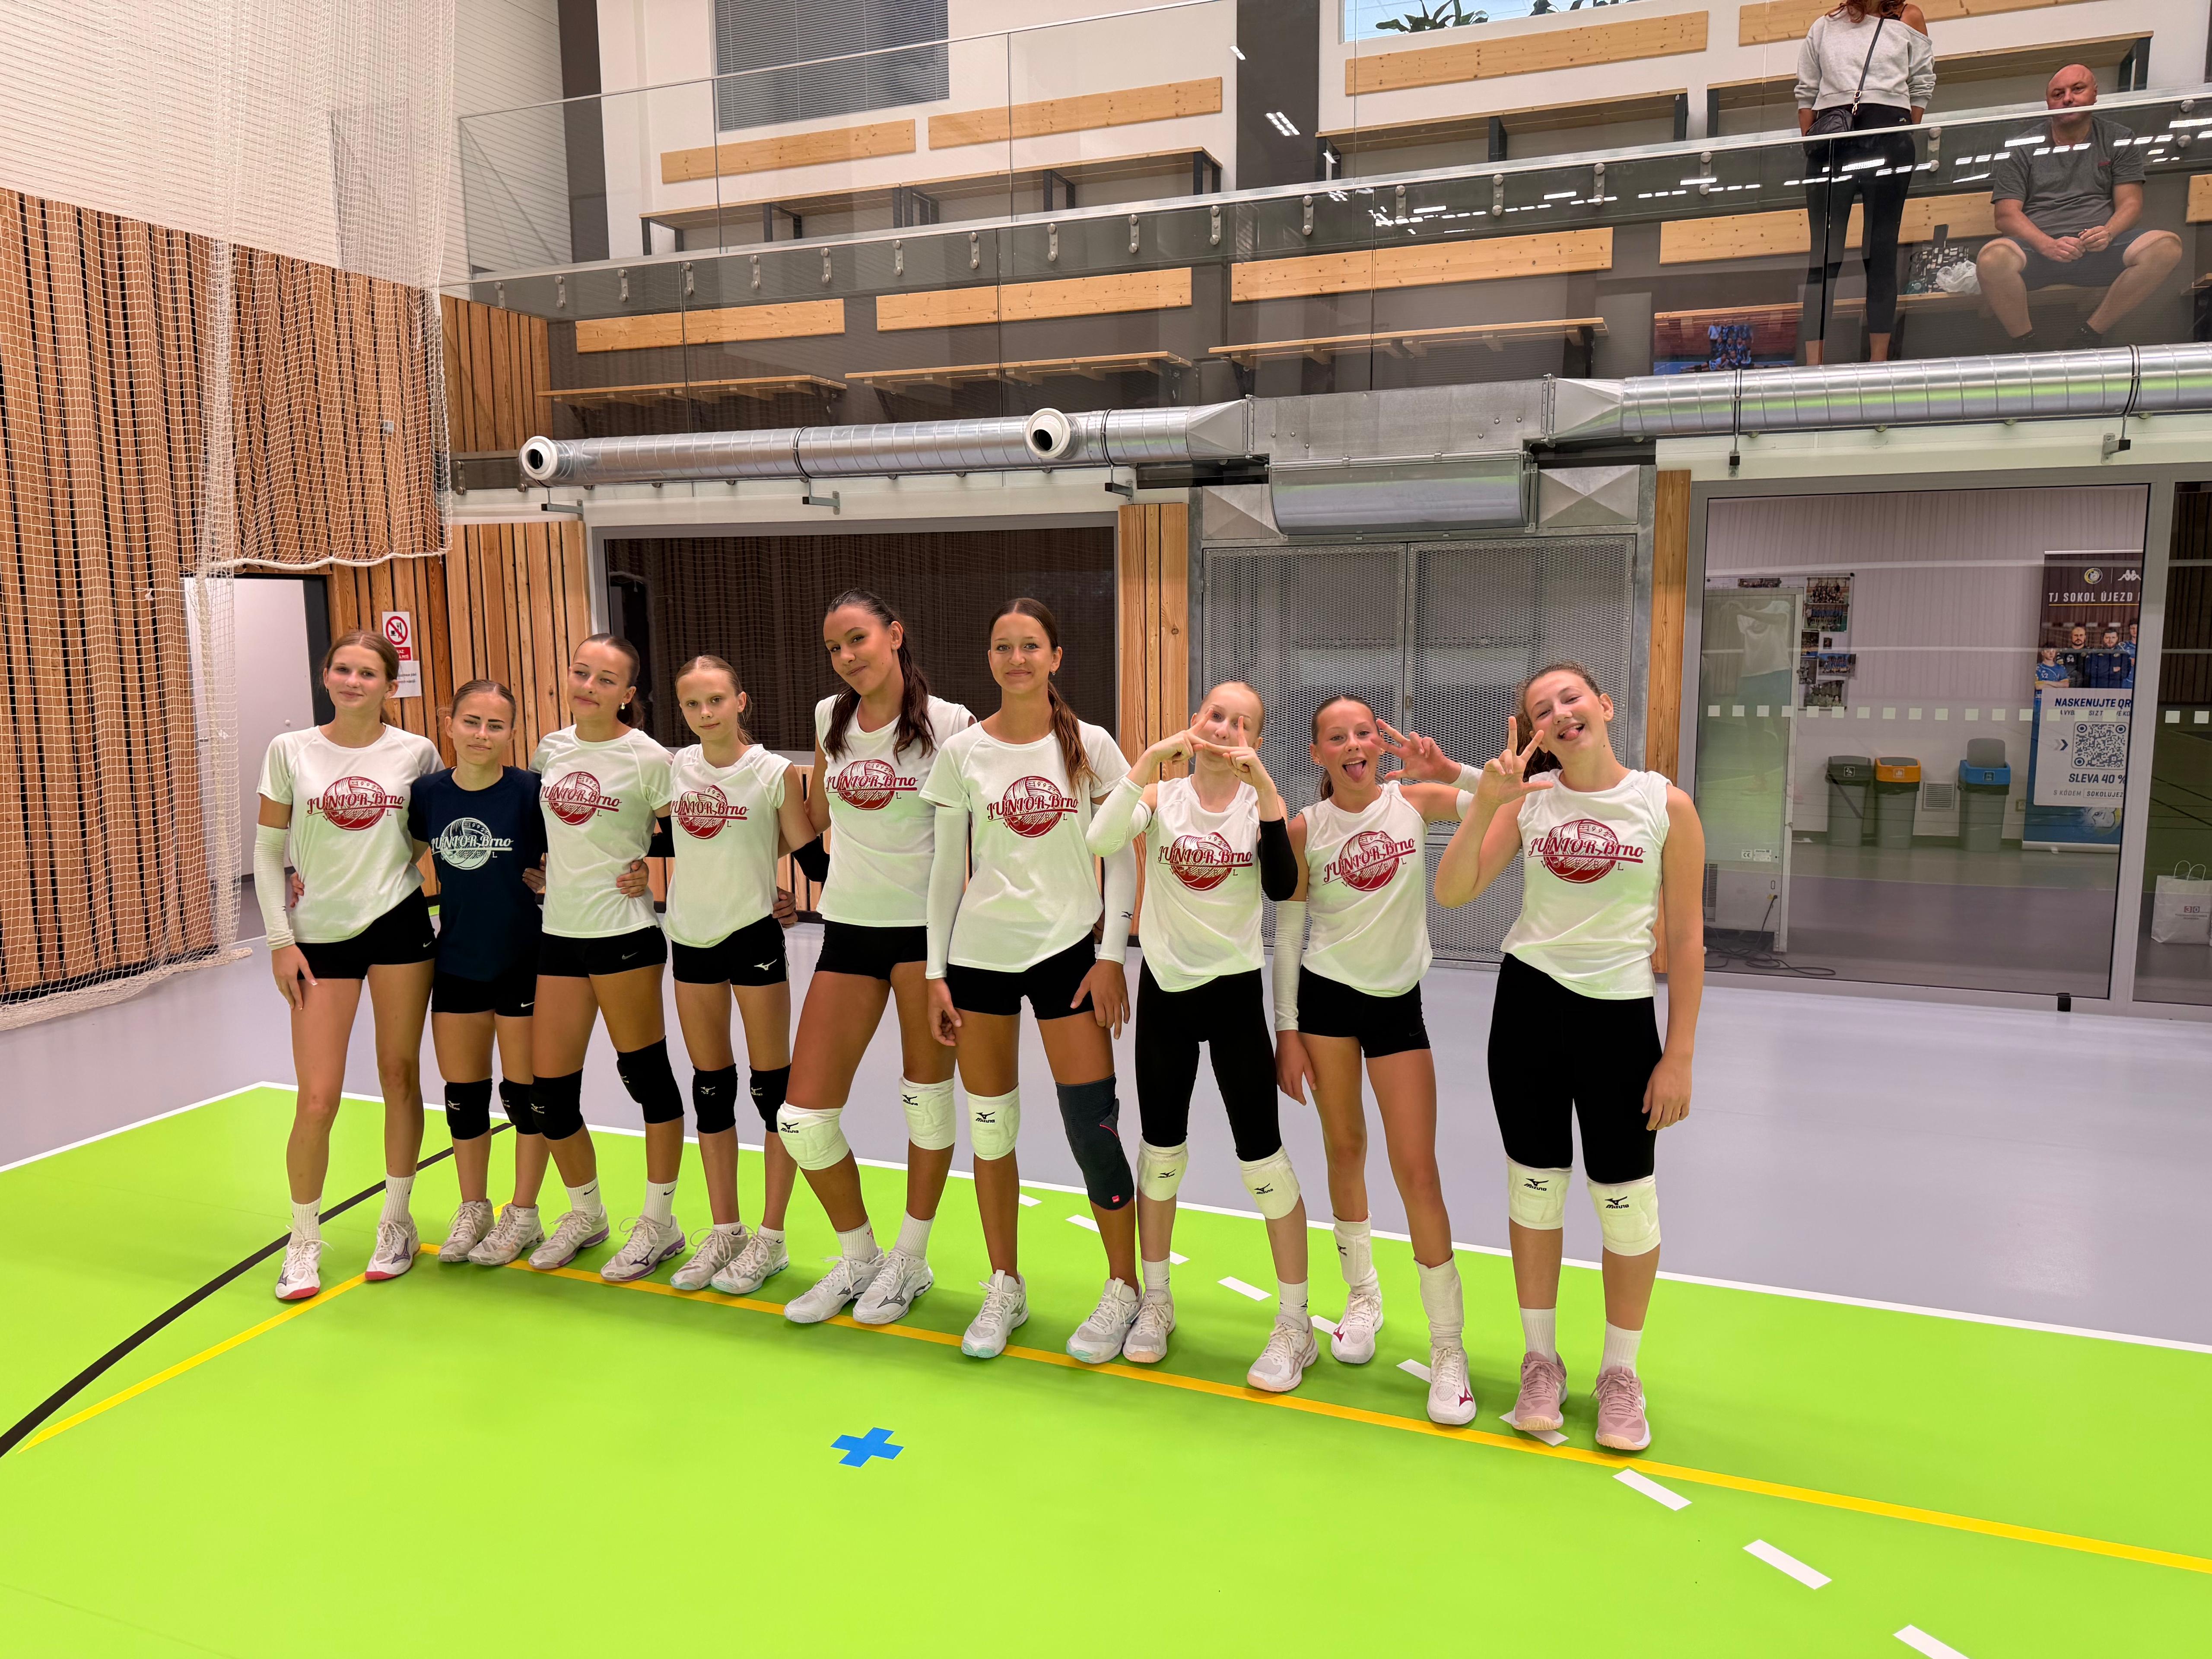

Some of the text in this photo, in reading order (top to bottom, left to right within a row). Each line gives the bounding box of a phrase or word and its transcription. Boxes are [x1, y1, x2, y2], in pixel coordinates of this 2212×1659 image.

[2048, 592, 2058, 602] TJ
[2063, 592, 2095, 602] SOKOL
[2101, 591, 2133, 602] ÚJEZD
[2055, 698, 2131, 709] NASKENUJTE QR
[826, 774, 919, 792] JUNIOR Brno
[2069, 773, 2098, 783] SLEVA
[2101, 775, 2115, 783] 40
[307, 791, 405, 814] JUNIOR Brno
[588, 791, 622, 807] Brno
[987, 794, 1079, 820] JUNIOR Brno
[716, 801, 750, 816] Brno
[480, 835, 514, 847] Brno
[1529, 837, 1646, 857] JUNIOR Brno
[1158, 845, 1252, 864] JUNIOR Brno
[1324, 838, 1415, 883] JUNIOR Brno
